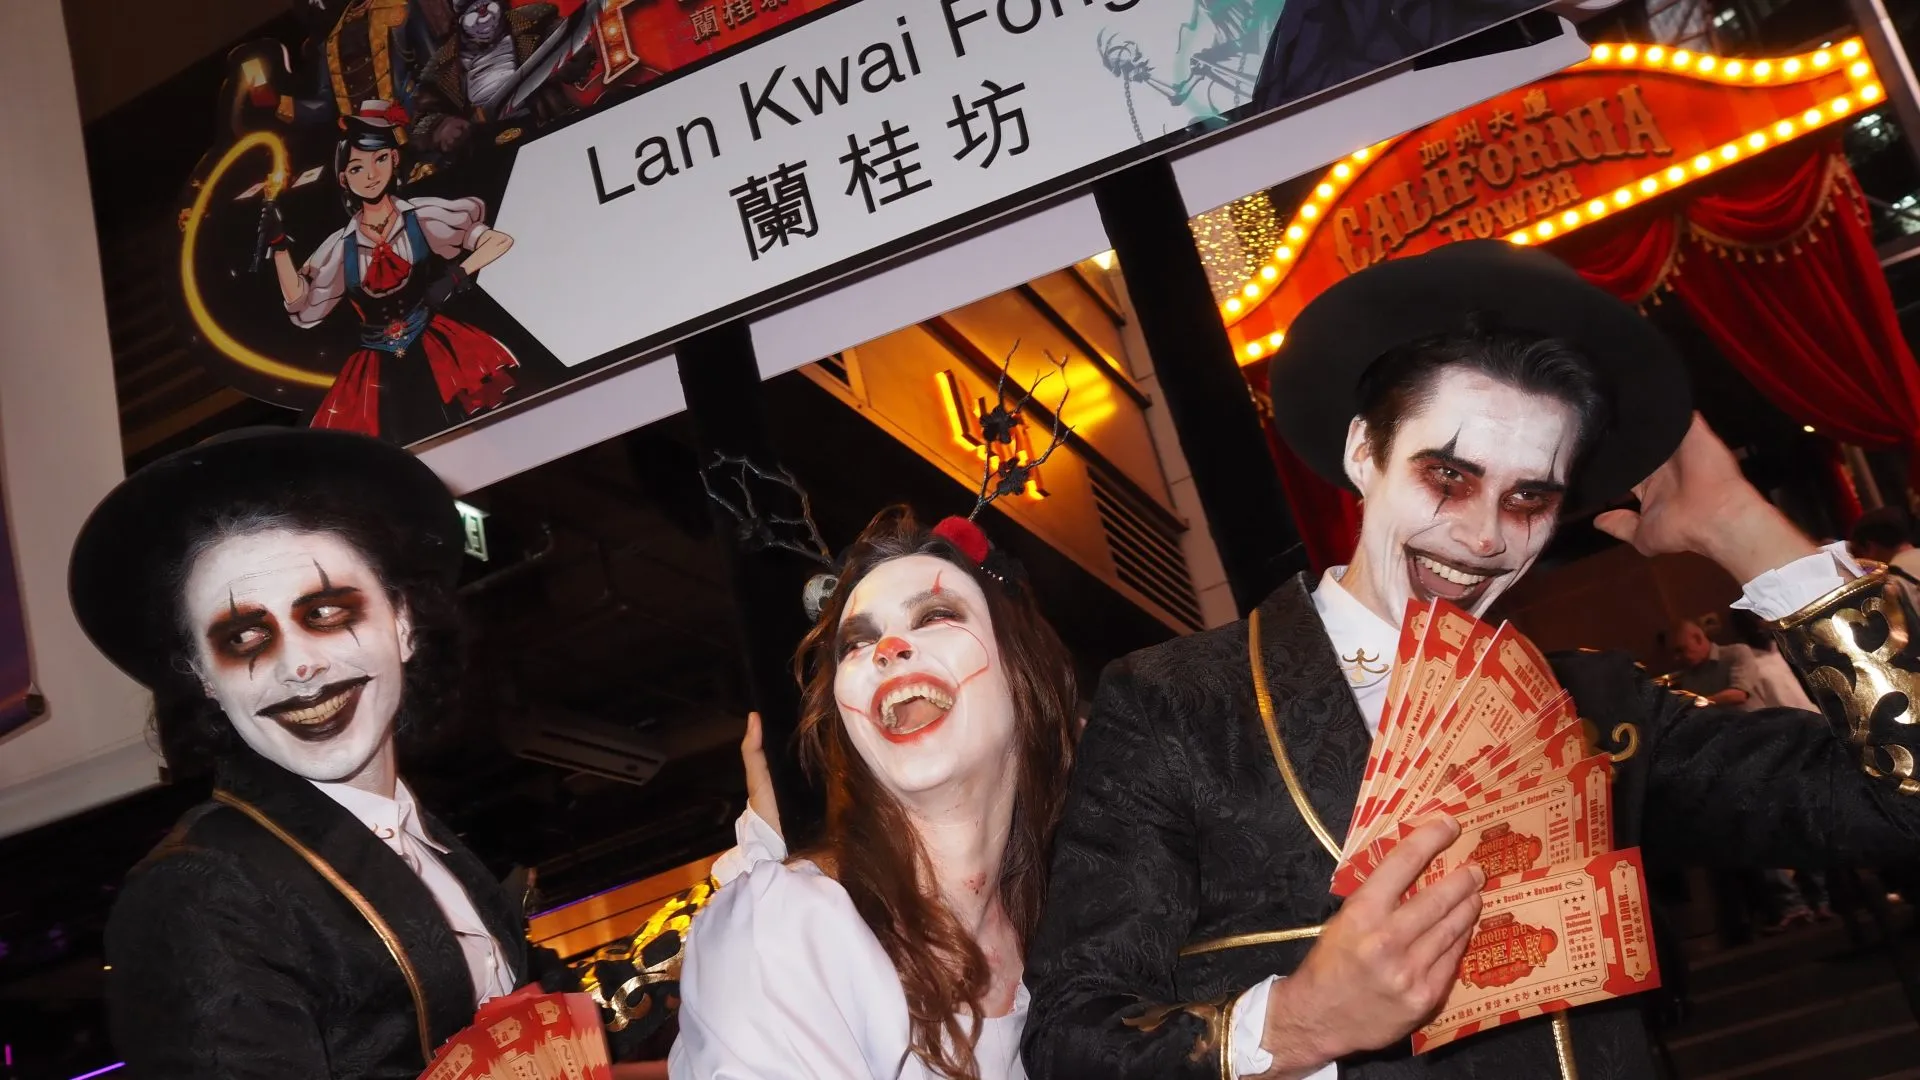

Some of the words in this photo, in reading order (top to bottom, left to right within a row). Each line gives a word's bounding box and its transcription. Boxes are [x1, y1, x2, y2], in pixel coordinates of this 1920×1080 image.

[587, 117, 721, 206] Lan
[739, 16, 921, 142] Kwai
[940, 0, 1141, 58] Fo
[729, 79, 1030, 262] 蘭桂坊
[1333, 83, 1674, 275] CALIFORNIA
[1438, 171, 1582, 243] TOWER
[1478, 841, 1531, 879] REAK
[1461, 934, 1545, 987] FREAK
[1470, 928, 1509, 949] CIRQUE
[1512, 924, 1528, 937] DU
[1622, 924, 1635, 945] YOU
